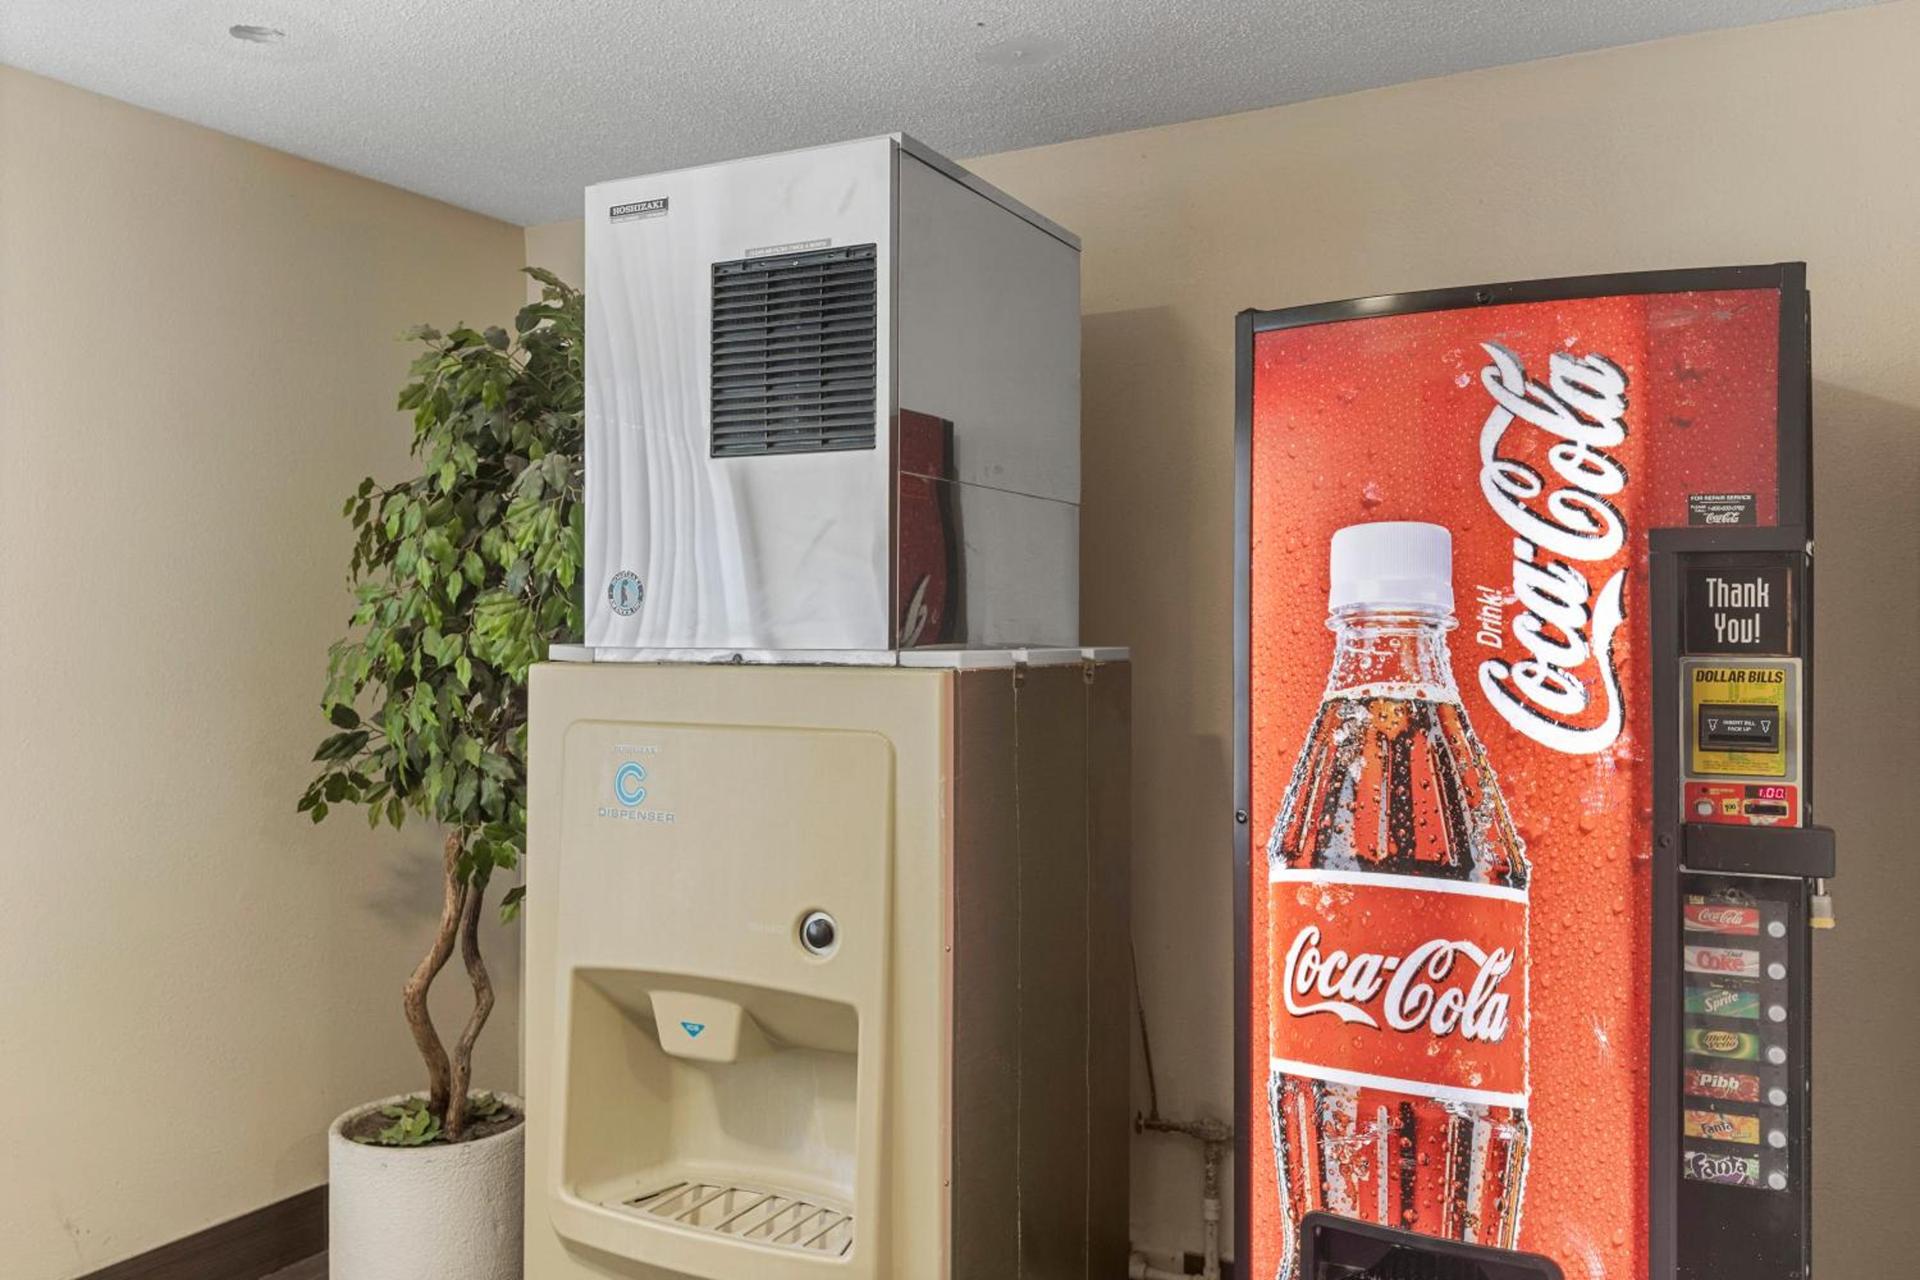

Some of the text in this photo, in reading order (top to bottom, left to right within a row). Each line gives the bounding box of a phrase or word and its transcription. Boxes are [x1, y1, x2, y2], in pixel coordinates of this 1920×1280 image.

[612, 200, 664, 216] HOSHIZAKI
[1478, 342, 1629, 755] Coca-Cola
[1706, 577, 1770, 608] Thank
[1476, 585, 1503, 650] Drink!
[1714, 612, 1760, 644] You!
[1695, 670, 1783, 684] DOLLAR BILLS
[598, 806, 676, 824] DISPENSER
[1696, 949, 1745, 972] Coke
[1283, 925, 1516, 1043] Coca-Cola
[1705, 990, 1738, 1013] Sprite
[1700, 1073, 1740, 1090] Pibb
[1701, 1121, 1733, 1134] Fanta
[1690, 1152, 1749, 1179] Fanta
